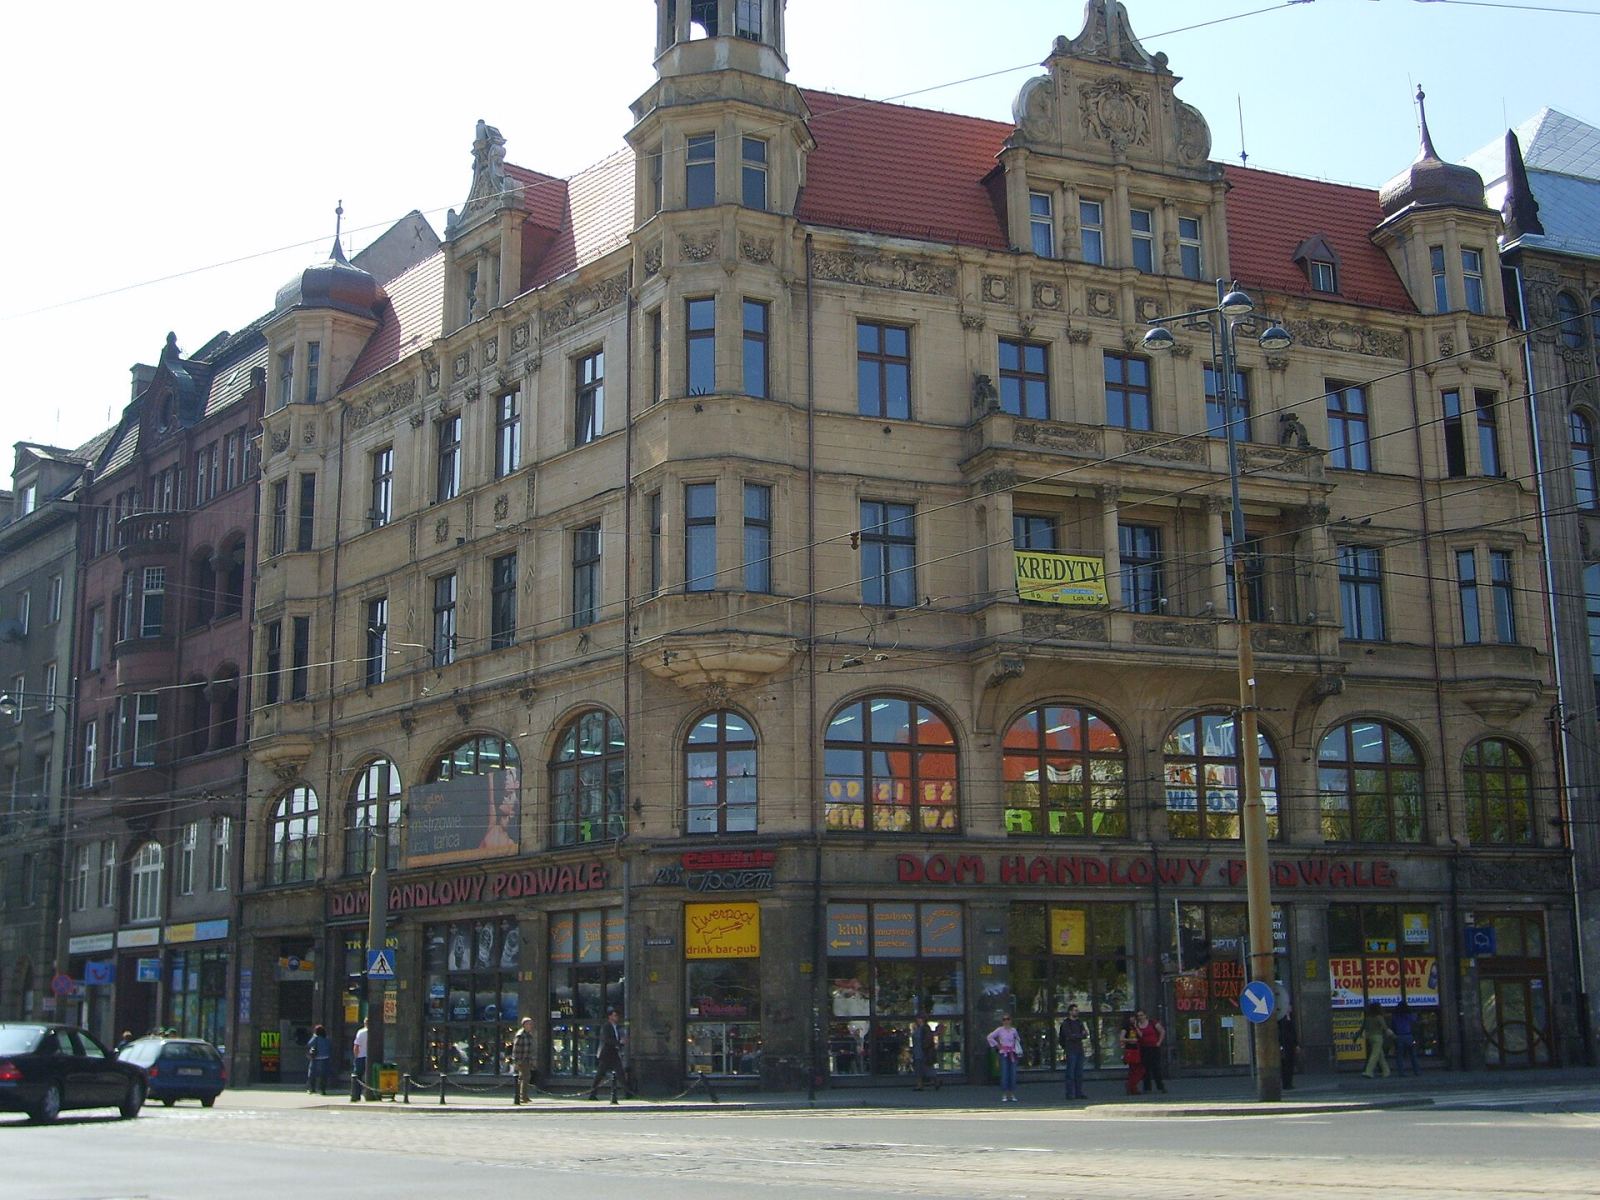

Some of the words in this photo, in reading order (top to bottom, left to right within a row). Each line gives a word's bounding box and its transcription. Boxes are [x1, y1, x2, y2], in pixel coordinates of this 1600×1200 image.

[1016, 556, 1100, 582] KREDYTY
[895, 854, 985, 883] DOM
[1000, 855, 1211, 886] HANDLOWY
[1228, 858, 1393, 888] PDWALE
[332, 891, 370, 916] DOM
[388, 876, 485, 911] ANDLOWY
[494, 863, 605, 897] PODWALE
[687, 945, 713, 954] drink
[716, 944, 757, 955] bar-pub
[1367, 941, 1397, 951] LOTTO
[1330, 959, 1429, 976] TELEFONY
[260, 1031, 280, 1048] RTV
